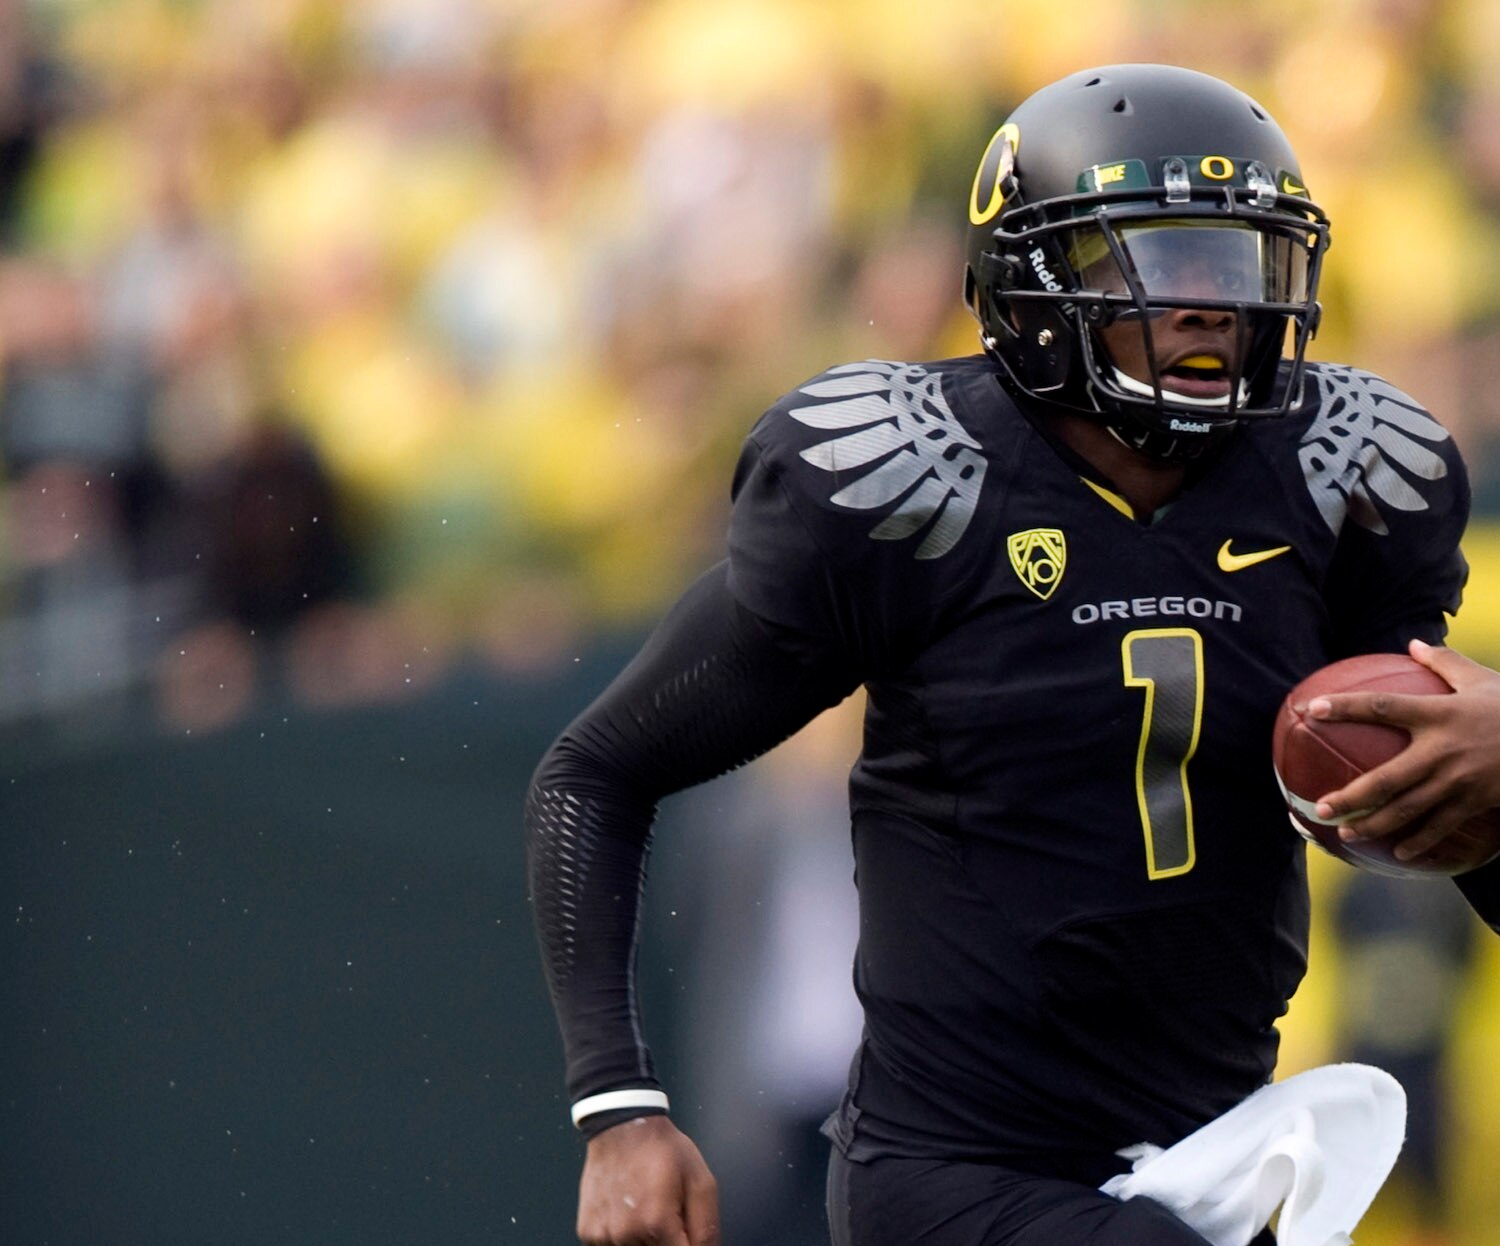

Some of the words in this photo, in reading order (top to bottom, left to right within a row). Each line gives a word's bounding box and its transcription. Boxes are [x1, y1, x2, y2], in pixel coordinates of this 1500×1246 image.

[1199, 155, 1235, 181] O
[1170, 418, 1212, 433] Riddell
[1010, 533, 1063, 574] PAC
[1027, 558, 1058, 586] 10
[1071, 596, 1242, 625] OREGON
[1121, 627, 1204, 881] 1
